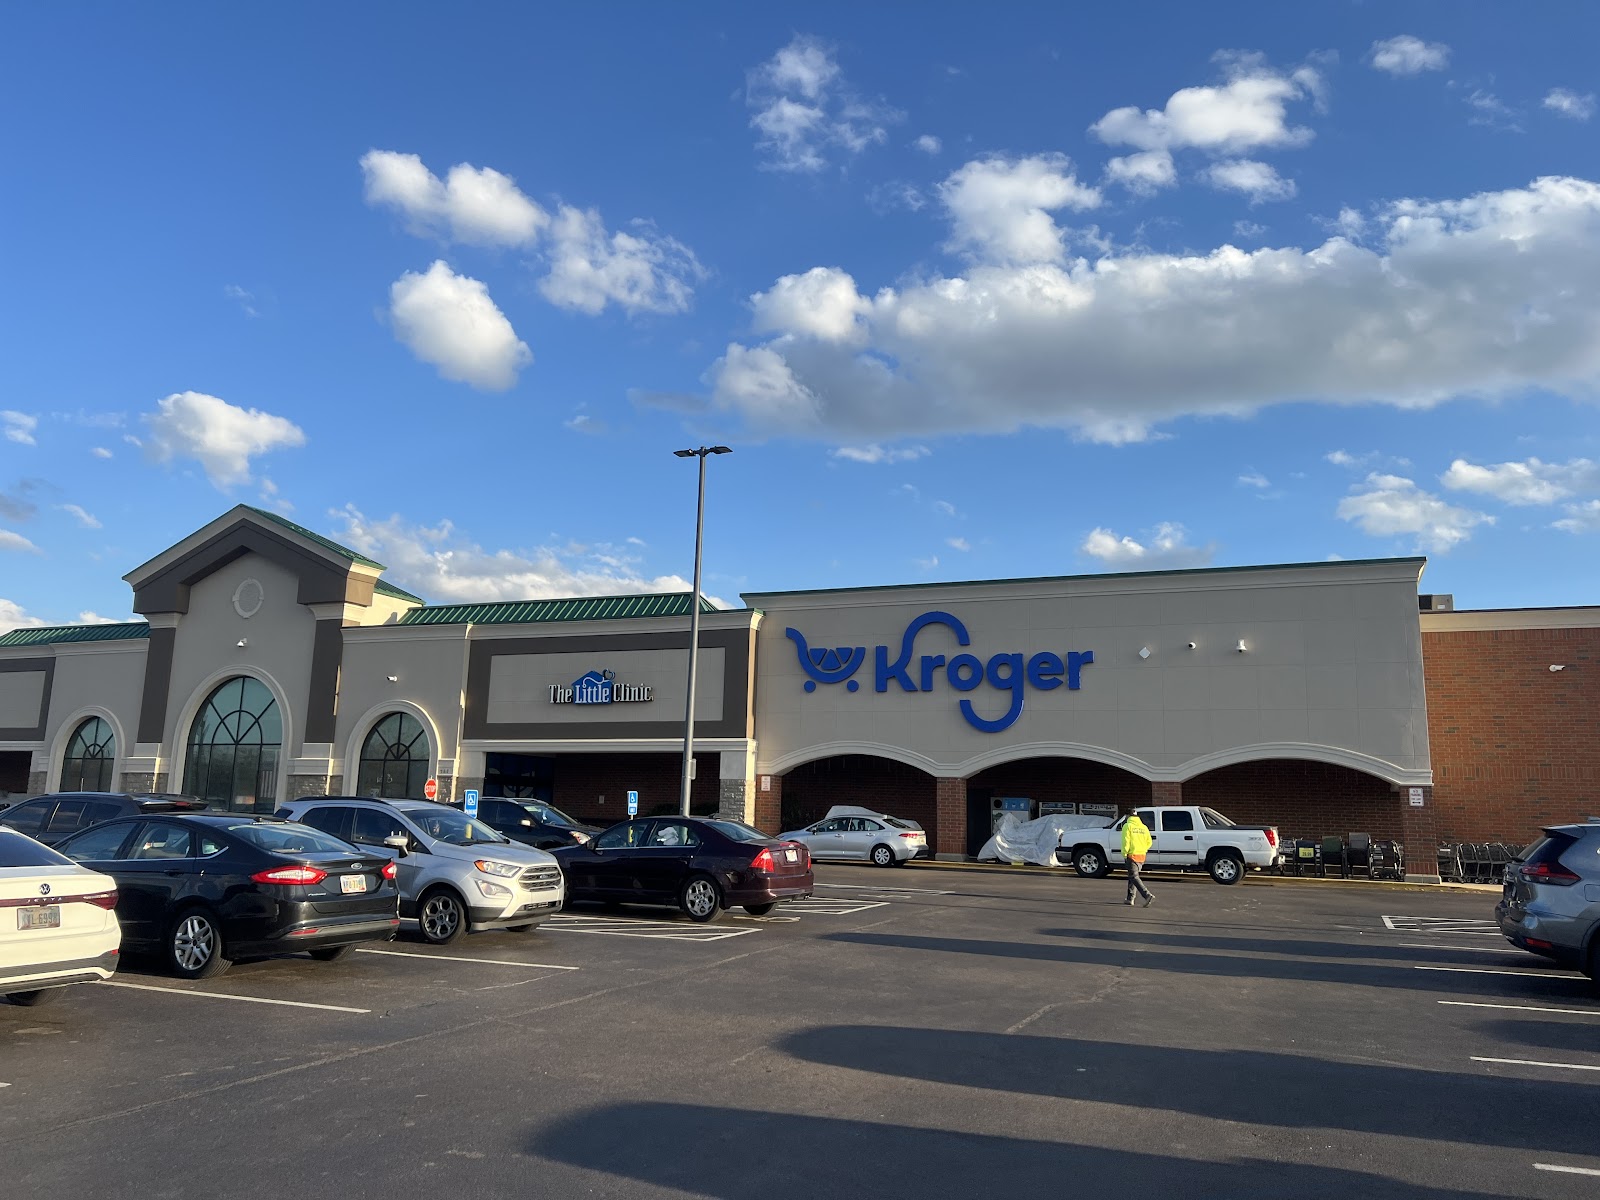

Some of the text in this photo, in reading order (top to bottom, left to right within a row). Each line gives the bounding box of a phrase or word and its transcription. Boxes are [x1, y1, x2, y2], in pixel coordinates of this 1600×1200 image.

[548, 683, 652, 704] The Little Clinic
[875, 611, 1095, 733] Kroger
